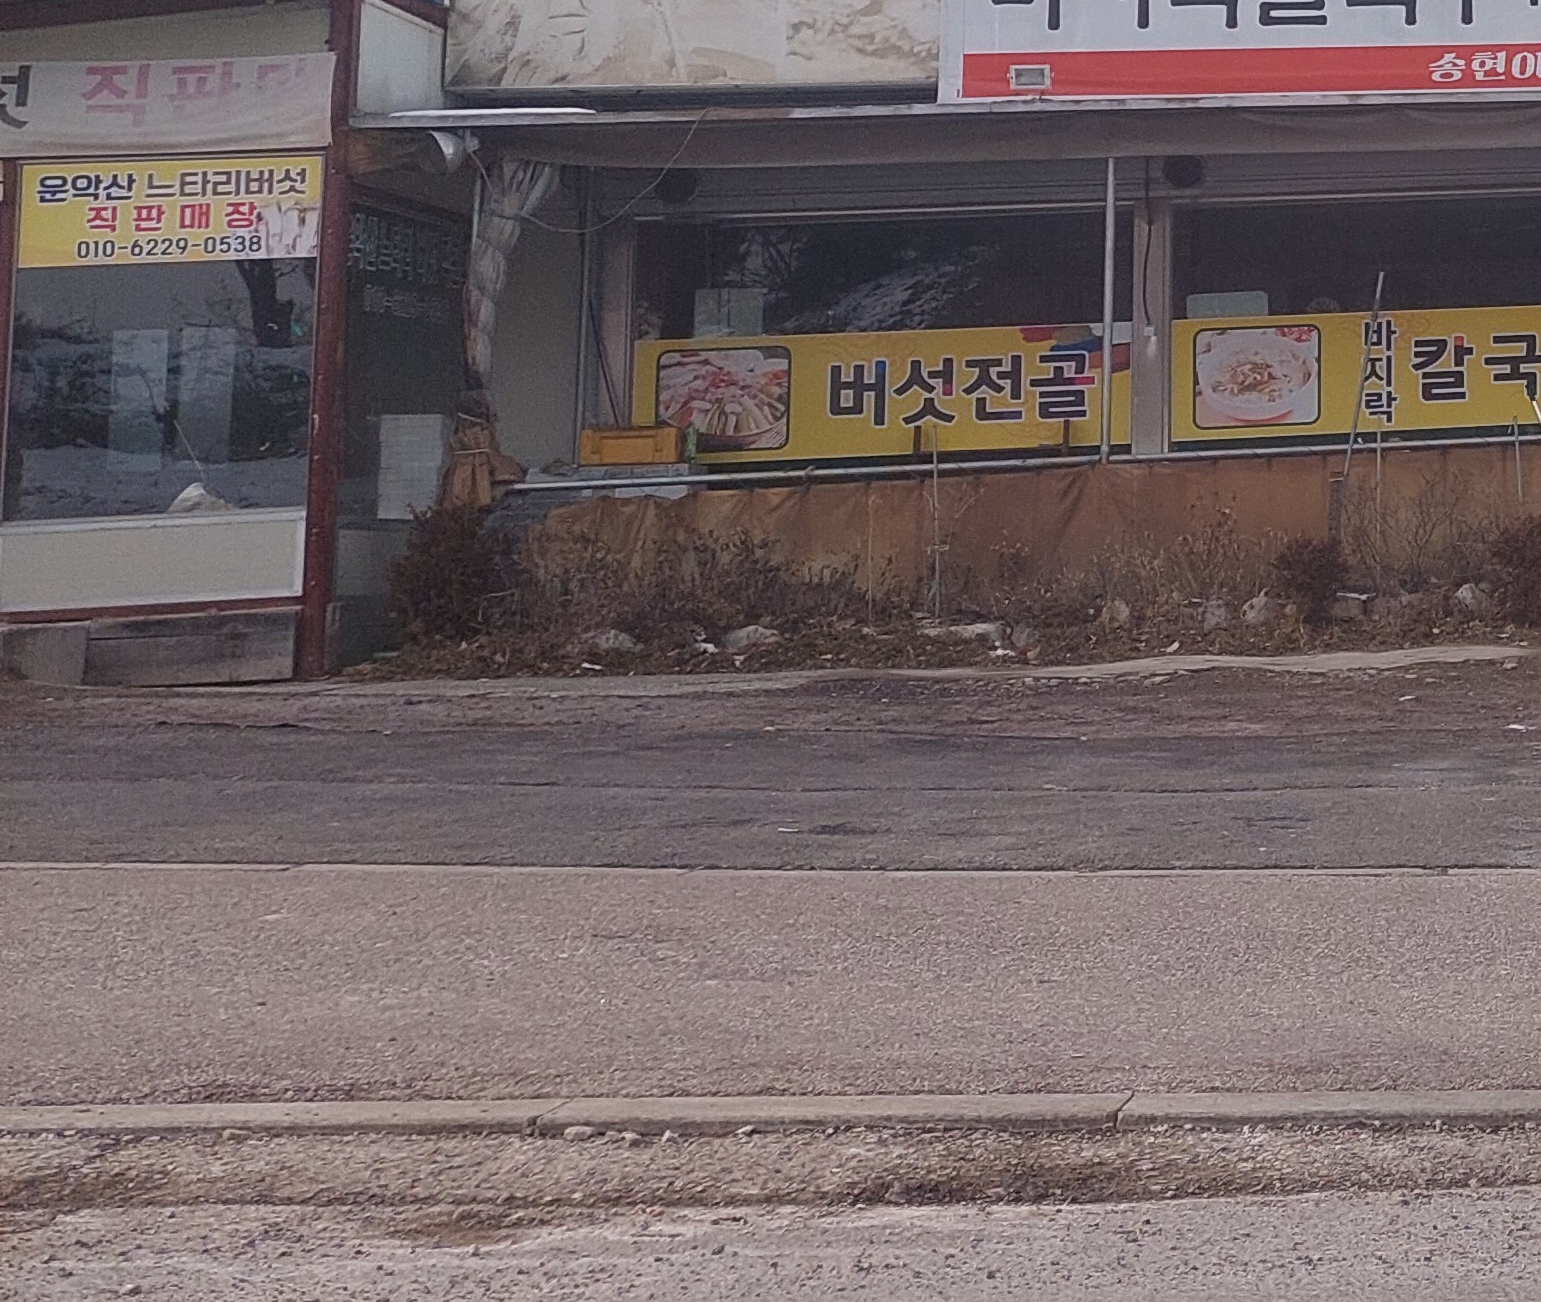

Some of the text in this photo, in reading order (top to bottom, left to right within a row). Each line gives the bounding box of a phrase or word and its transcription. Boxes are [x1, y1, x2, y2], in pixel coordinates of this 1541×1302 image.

[80, 60, 306, 128] 직판
[37, 167, 308, 203] 운악산 느타리버섯
[76, 235, 262, 259] 010-6229-0538
[829, 353, 1095, 426] 버섯전골
